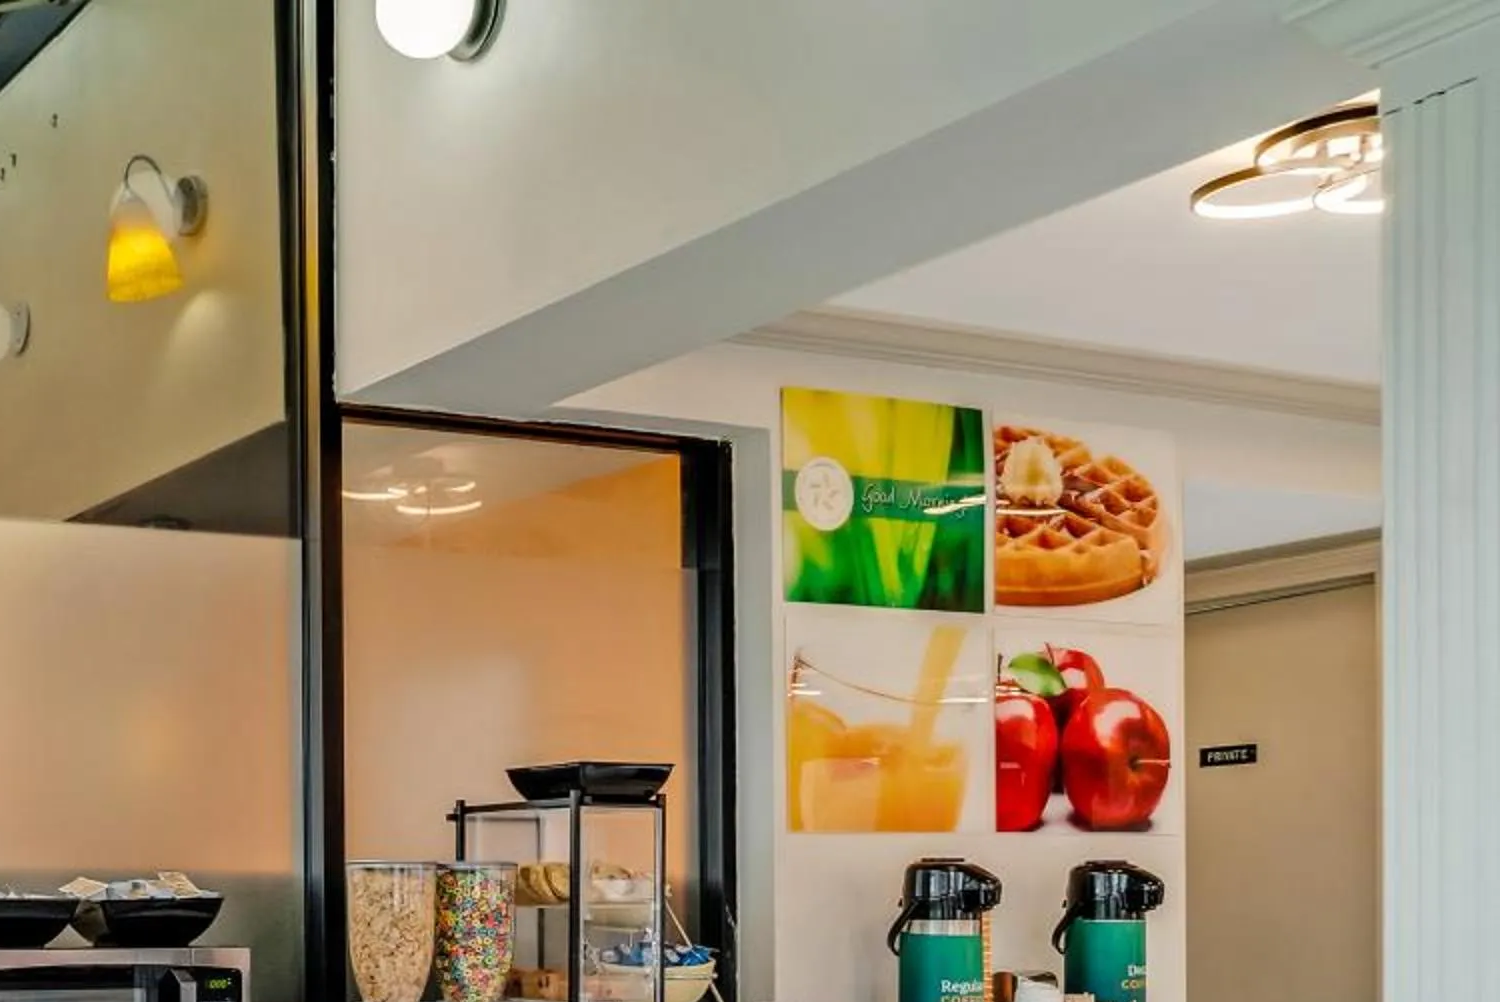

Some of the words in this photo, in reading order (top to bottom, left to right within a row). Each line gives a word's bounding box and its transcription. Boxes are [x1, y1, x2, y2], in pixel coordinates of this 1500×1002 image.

[862, 483, 895, 513] Good
[1207, 749, 1249, 763] PRIVATE
[941, 978, 984, 995] Regula
